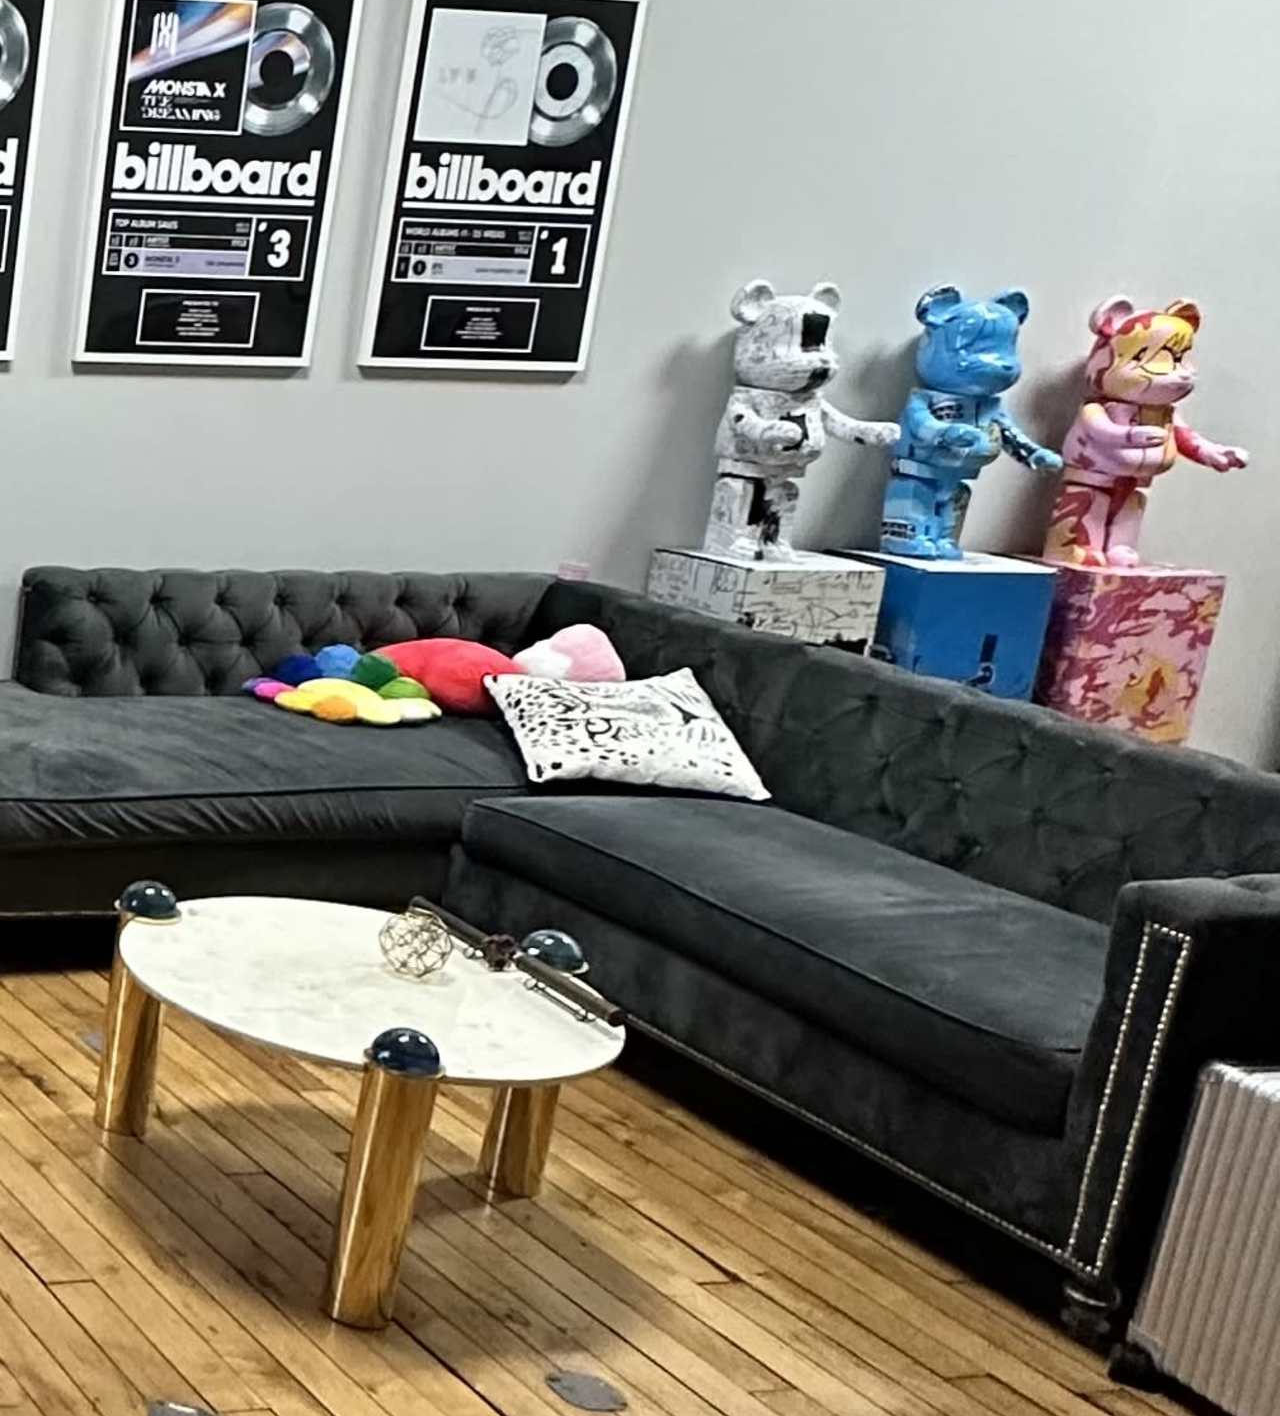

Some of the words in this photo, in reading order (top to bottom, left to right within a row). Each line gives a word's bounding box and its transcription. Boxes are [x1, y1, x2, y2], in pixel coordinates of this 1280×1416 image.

[143, 79, 212, 97] MONSTA
[213, 82, 227, 98] X
[111, 142, 322, 197] billboard
[403, 152, 602, 206] billboard
[115, 218, 130, 228] TOP
[130, 219, 156, 229] ALBUM
